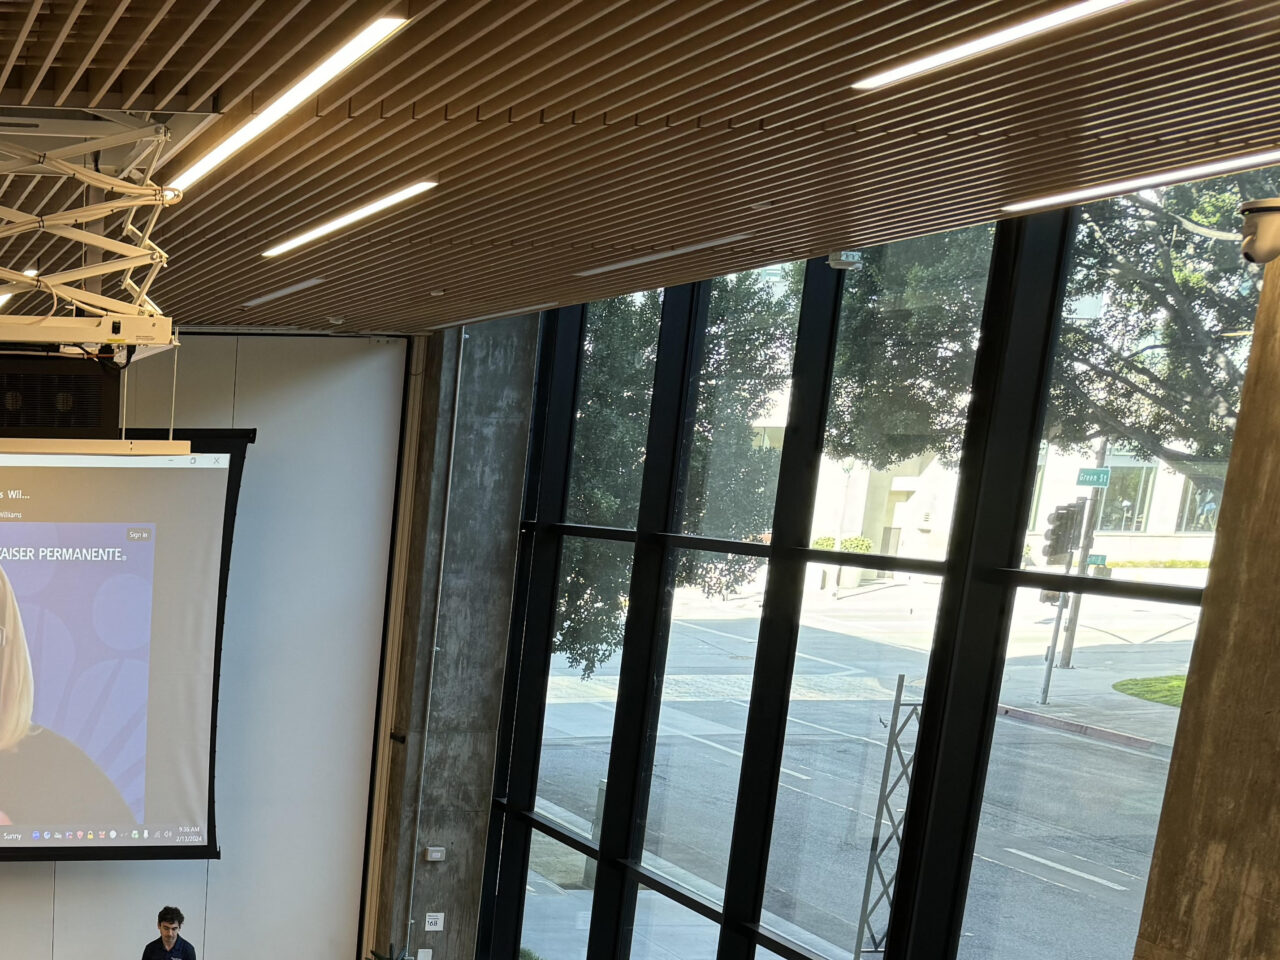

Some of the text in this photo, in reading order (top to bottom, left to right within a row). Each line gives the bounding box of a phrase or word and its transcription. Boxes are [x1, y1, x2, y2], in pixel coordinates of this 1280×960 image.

[1080, 473, 1107, 482] Green St
[129, 531, 141, 539] Sign
[3, 832, 22, 841] Sunny
